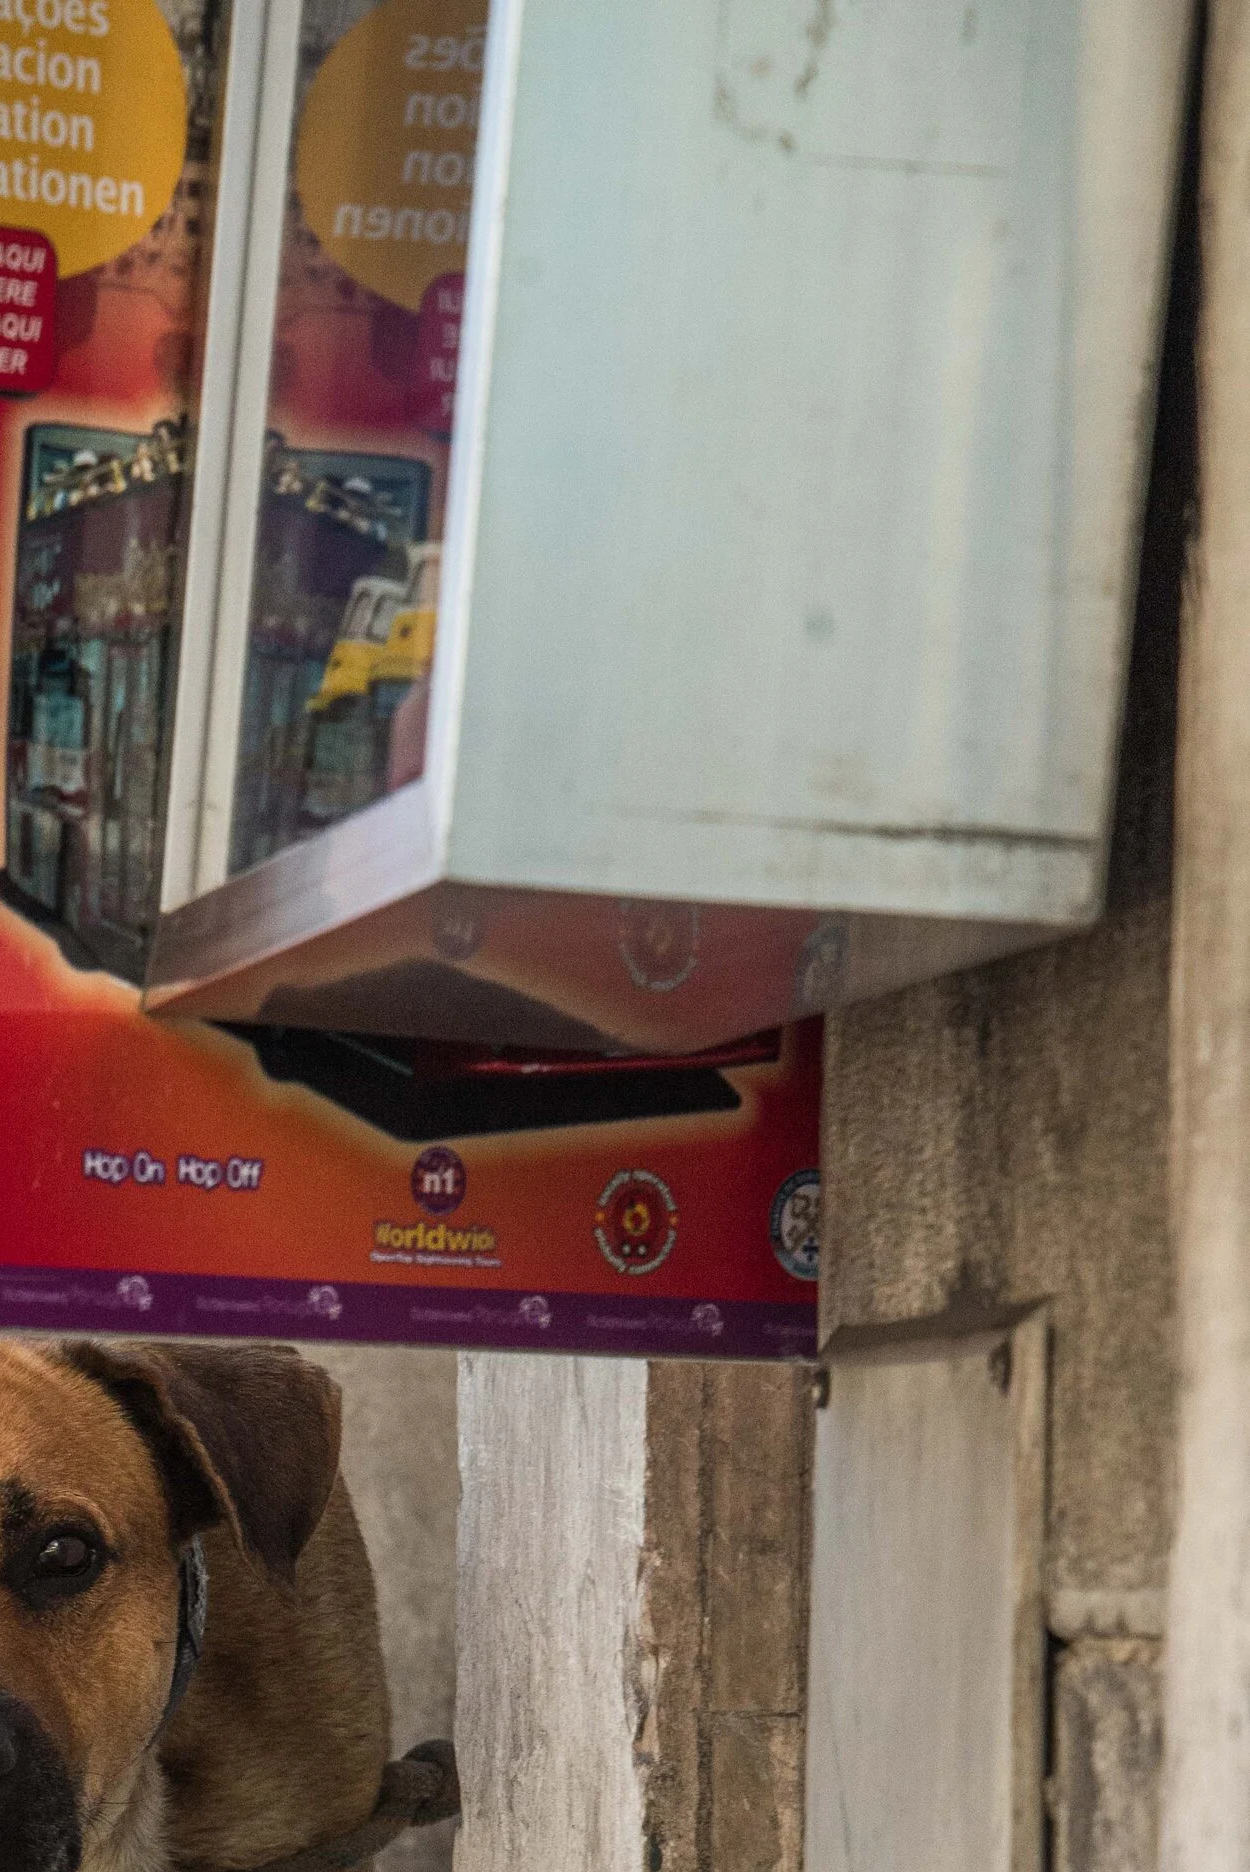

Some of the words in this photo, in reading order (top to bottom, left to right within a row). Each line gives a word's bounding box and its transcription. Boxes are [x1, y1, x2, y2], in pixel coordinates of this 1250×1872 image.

[83, 1149, 129, 1184] Hop
[133, 1150, 166, 1184] On
[177, 1156, 223, 1189] Hop
[226, 1157, 263, 1189] Off
